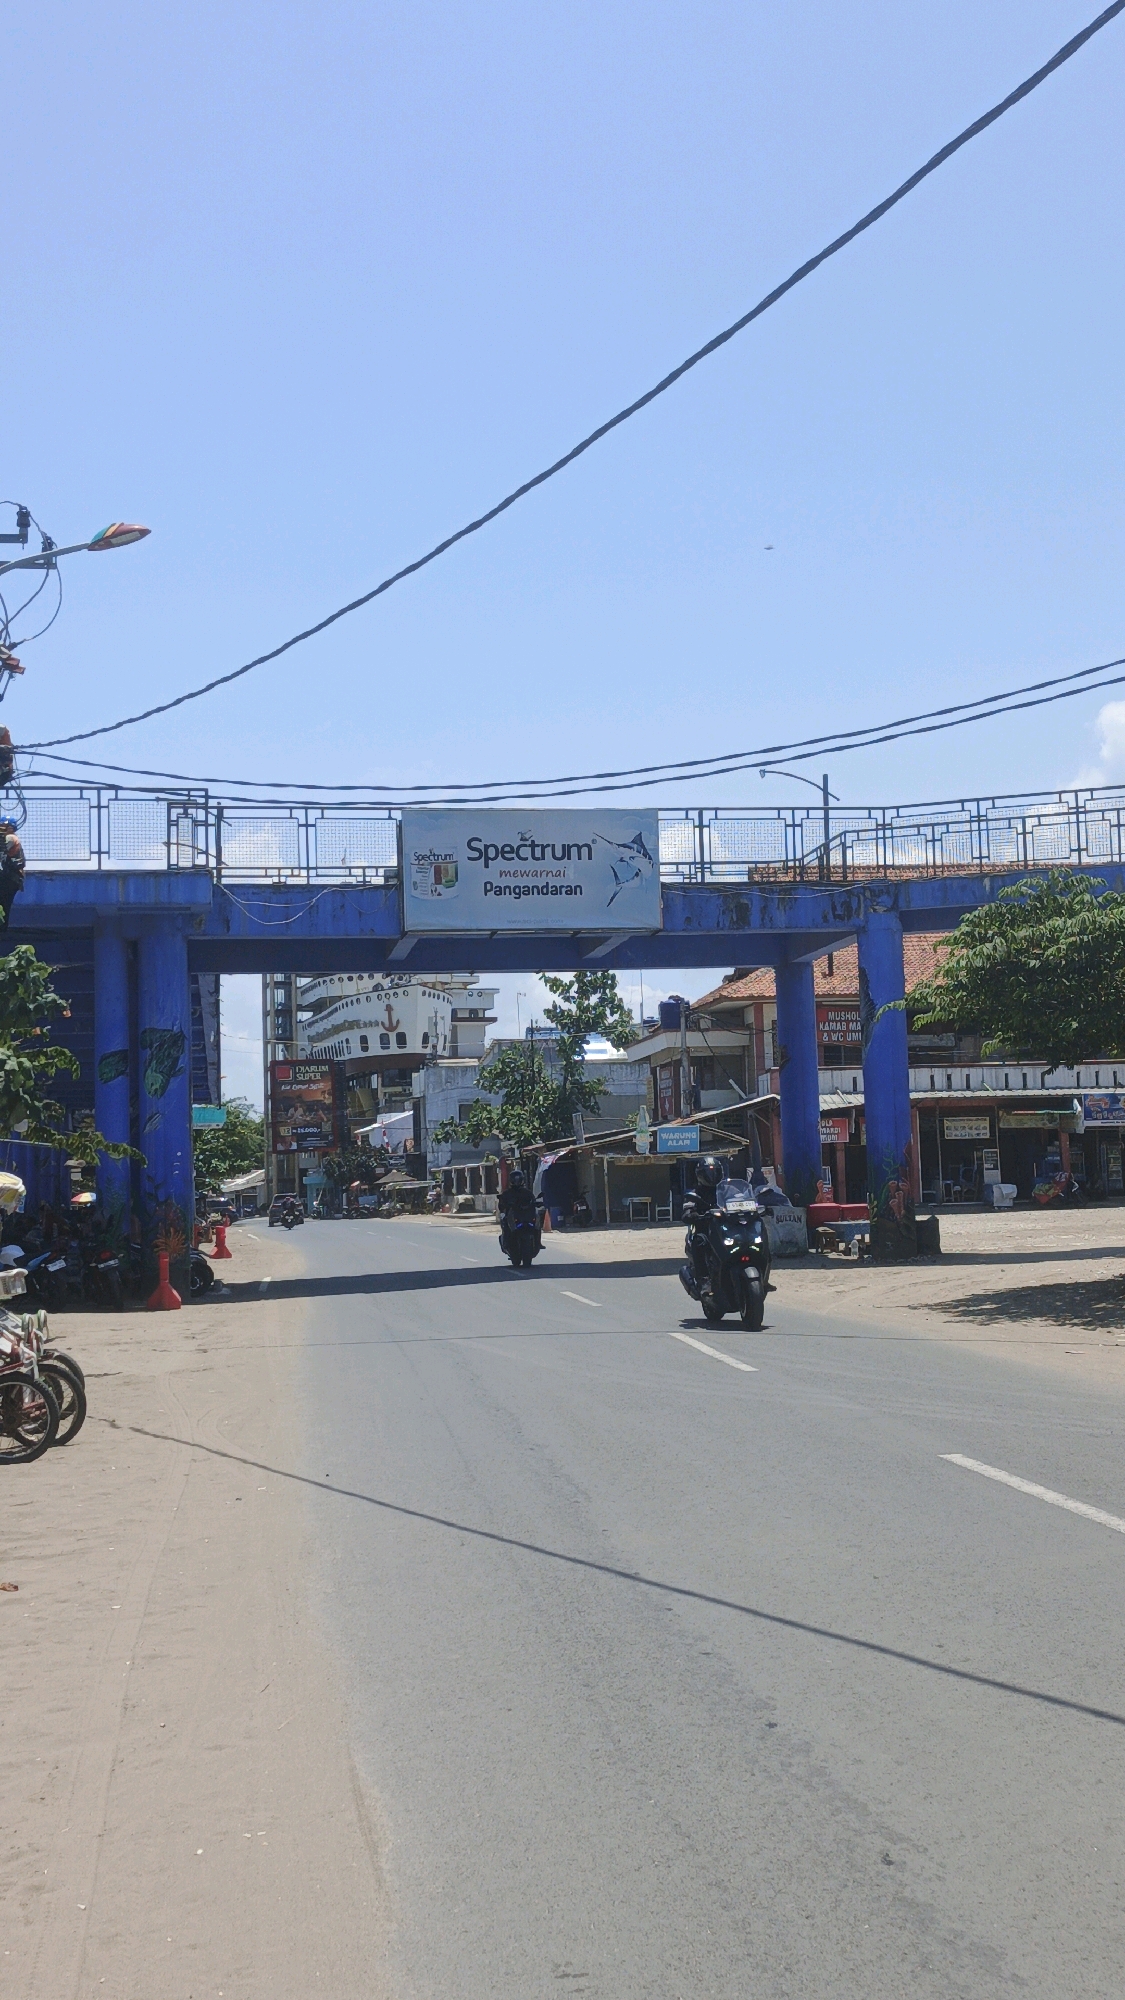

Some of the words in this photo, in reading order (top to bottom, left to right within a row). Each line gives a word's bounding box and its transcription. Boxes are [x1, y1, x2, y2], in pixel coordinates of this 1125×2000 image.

[466, 836, 593, 869] Spectrum
[413, 851, 454, 865] Spectrum
[499, 866, 567, 878] mewarnai
[483, 880, 583, 899] Pangandaran
[849, 1021, 862, 1031] MA
[822, 1032, 829, 1042] &
[830, 1032, 844, 1042] WC
[296, 1065, 329, 1073] DJARUM
[296, 1072, 321, 1081] SUPER
[660, 1132, 698, 1140] WARUNG
[775, 1214, 802, 1224] SULTAN
